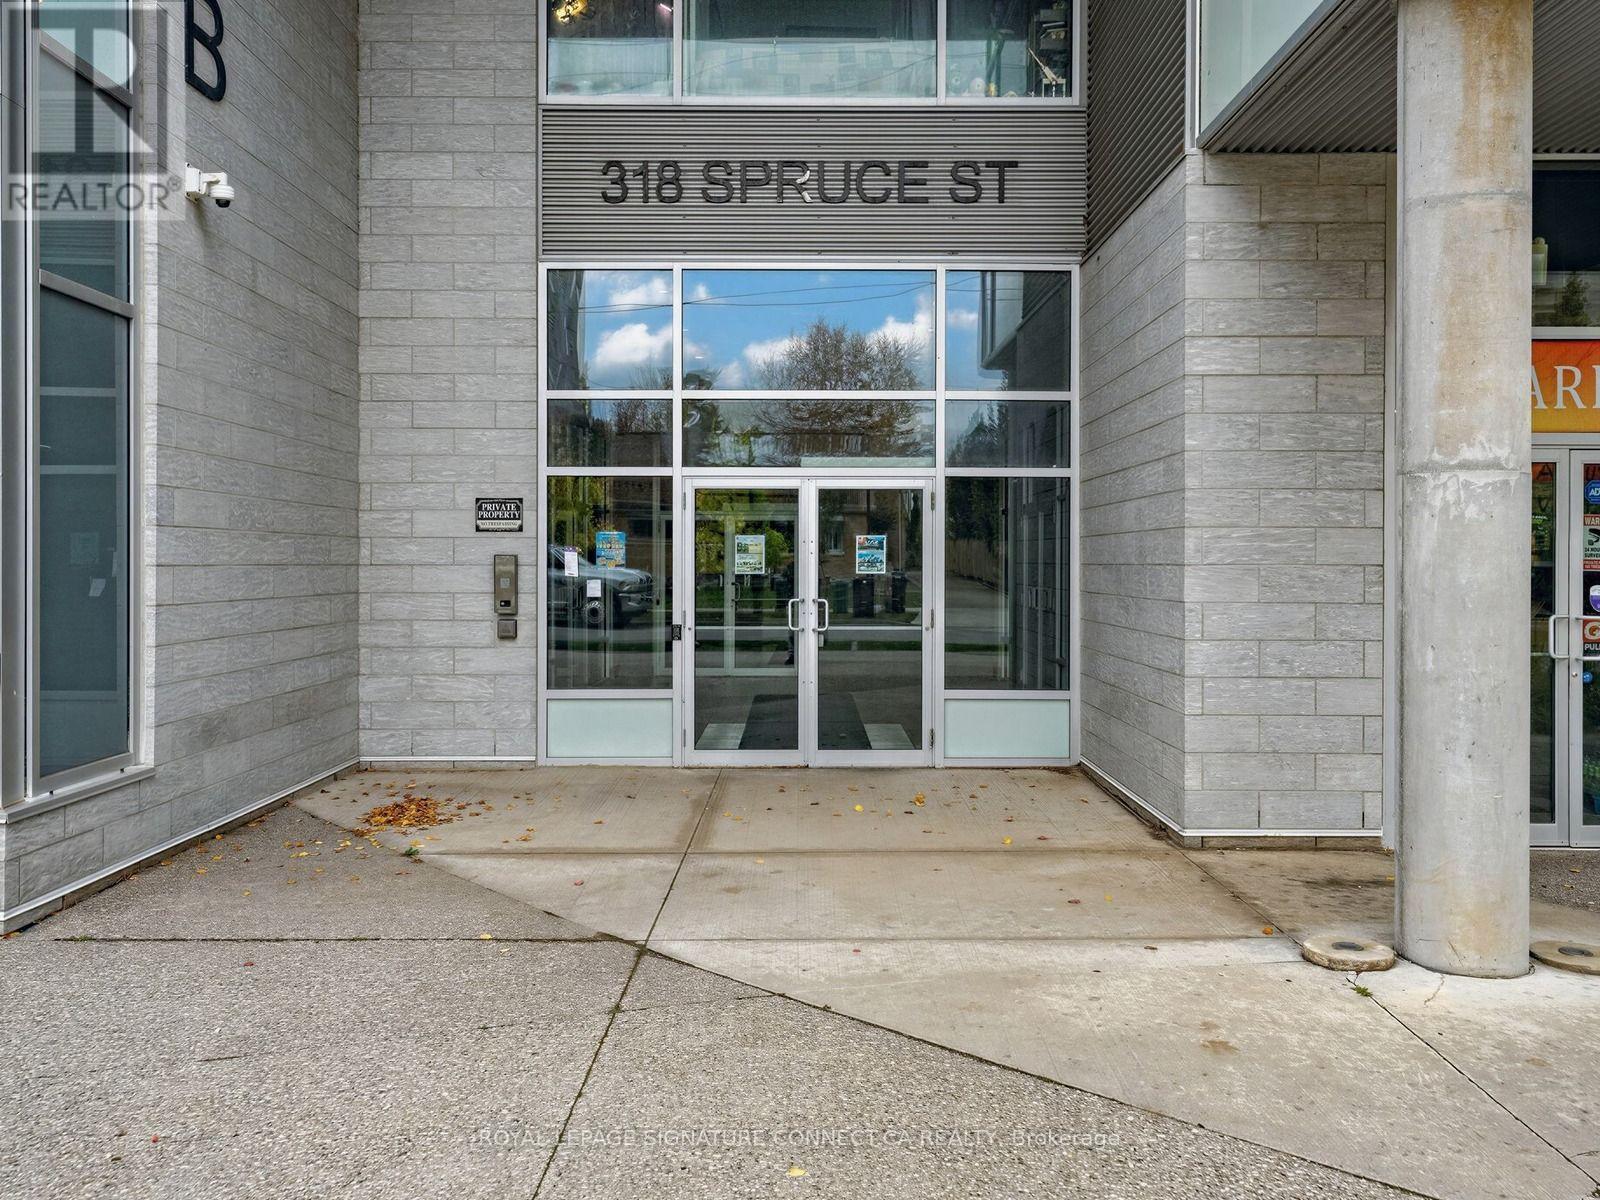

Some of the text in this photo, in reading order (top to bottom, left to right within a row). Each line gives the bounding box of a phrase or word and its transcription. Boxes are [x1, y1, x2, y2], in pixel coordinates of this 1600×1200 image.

[601, 160, 1019, 205] 318 SPRUCE ST
[481, 503, 517, 511] PRIVATE
[478, 511, 520, 519] PROPERTY
